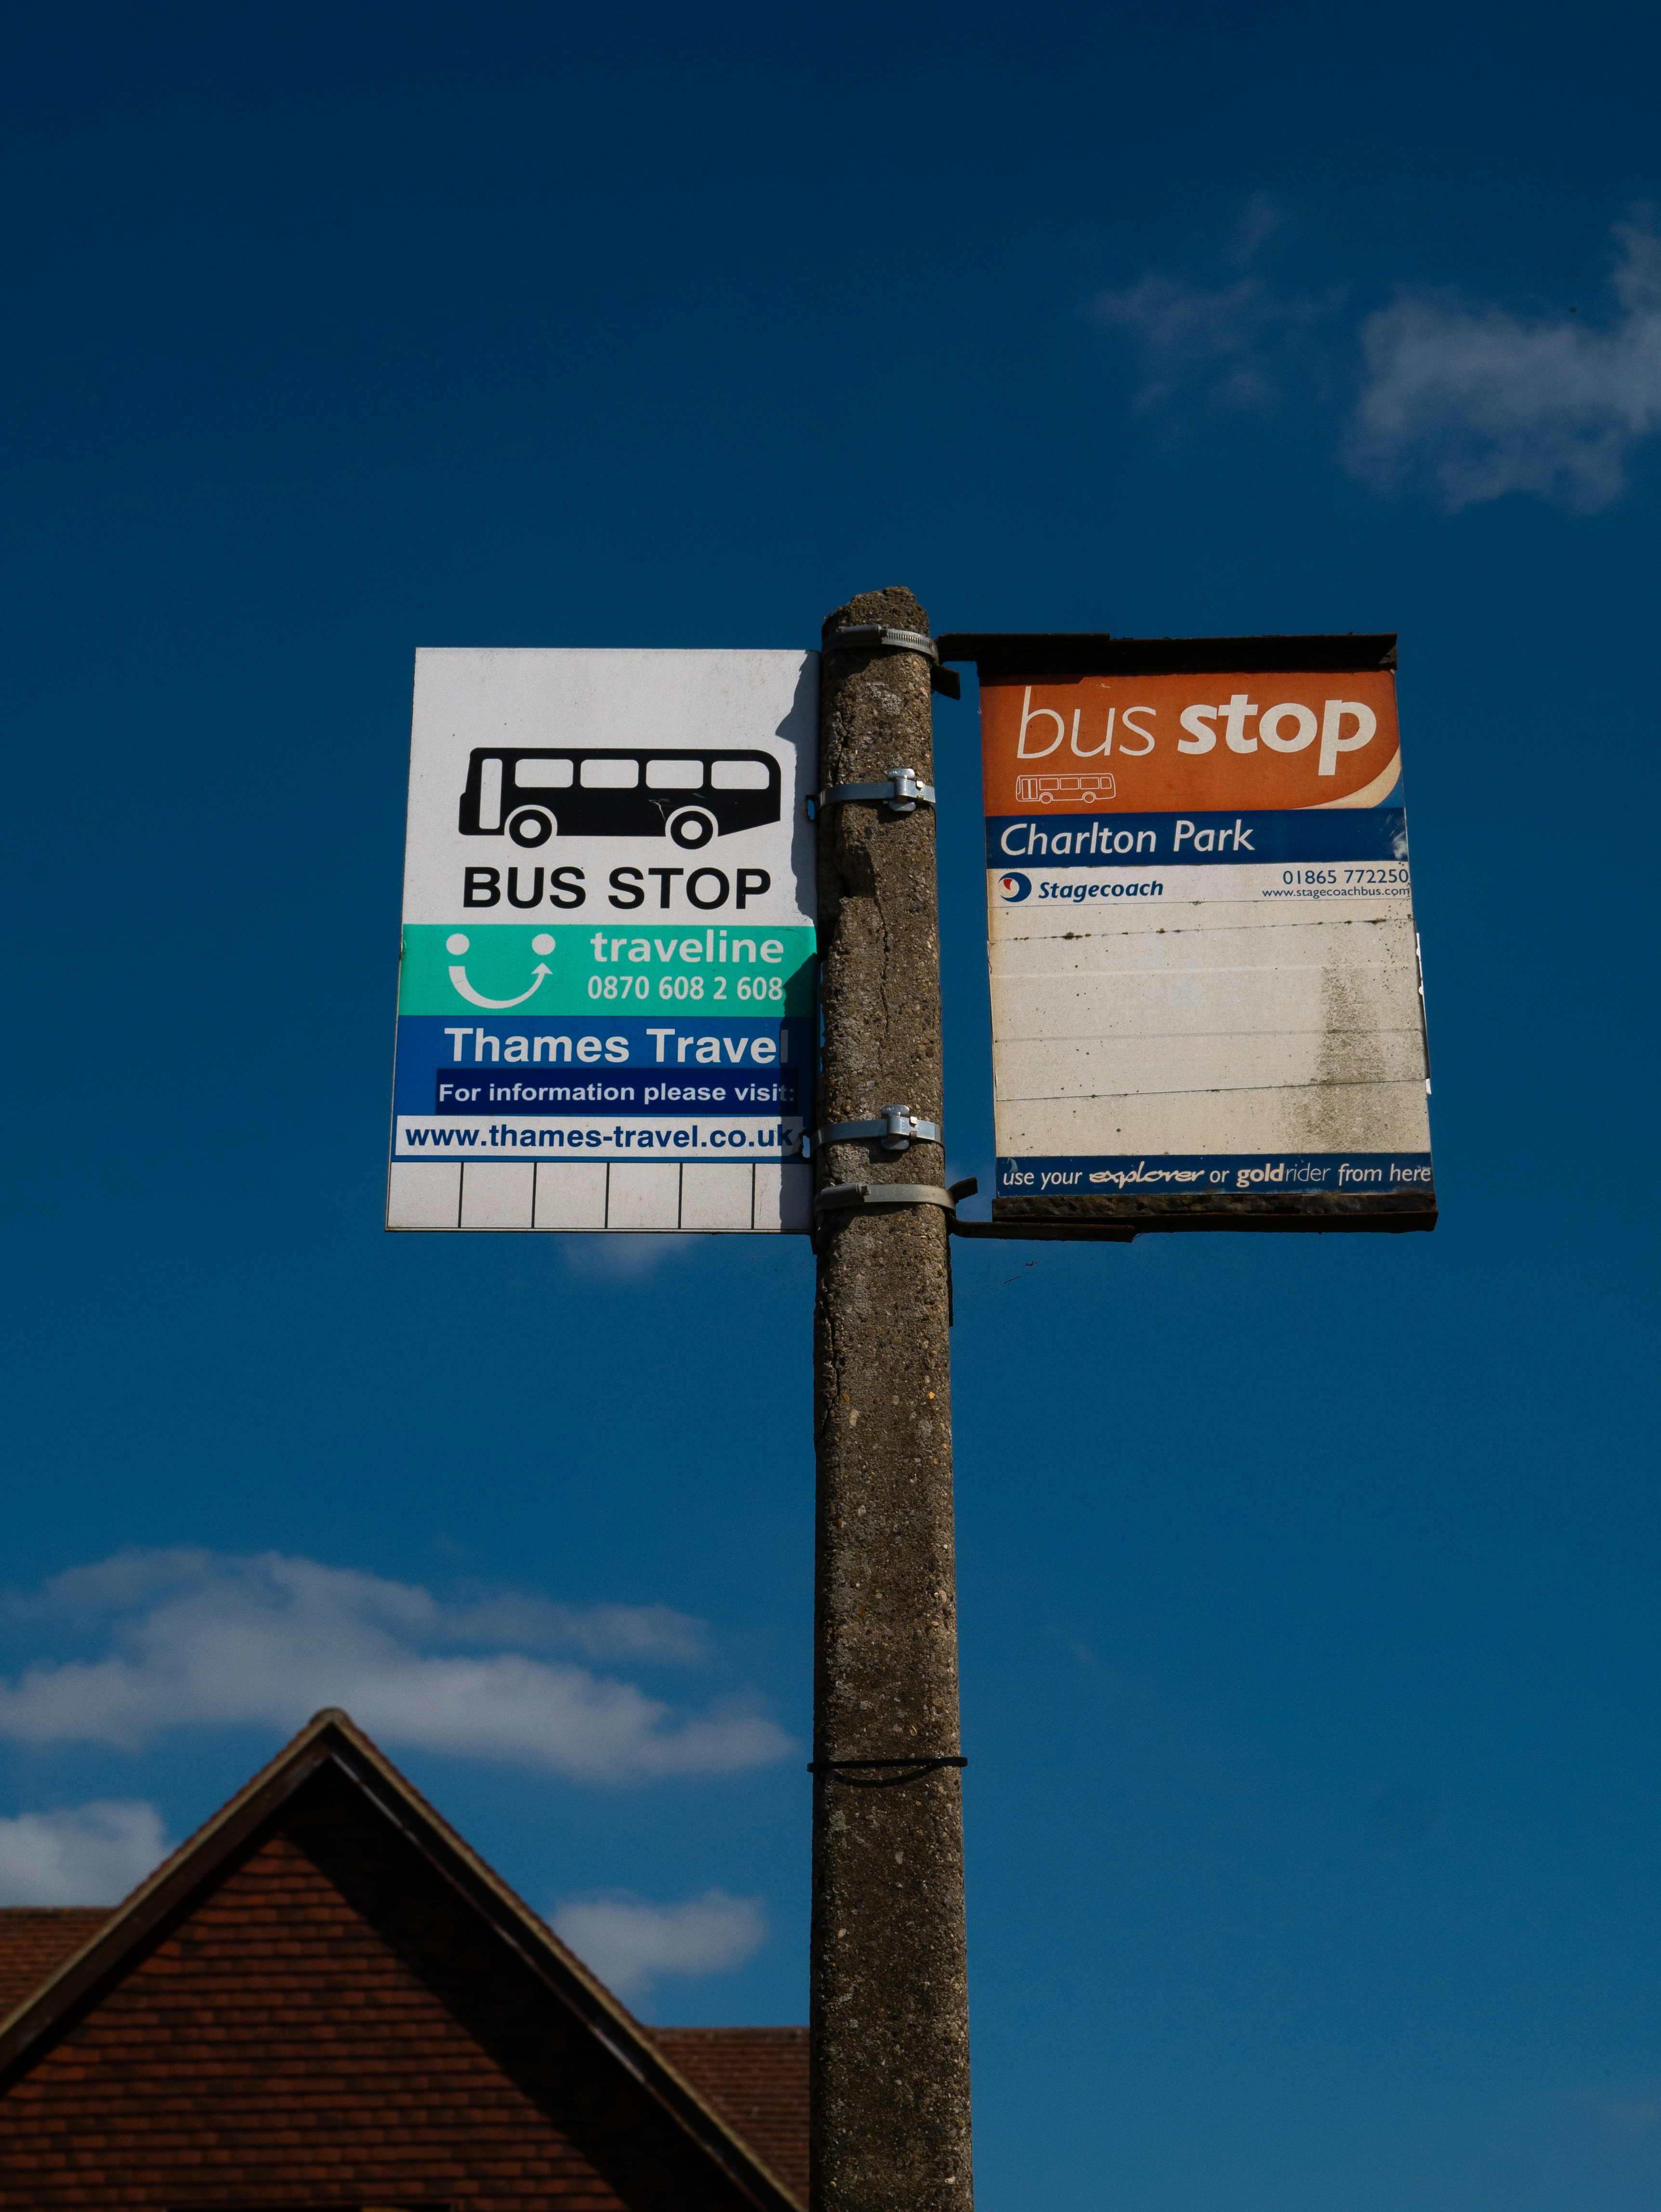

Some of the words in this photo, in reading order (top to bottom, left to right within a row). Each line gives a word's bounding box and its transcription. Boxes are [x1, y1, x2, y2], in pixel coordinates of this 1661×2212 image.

[1017, 686, 1157, 759] bus
[1177, 694, 1377, 776] stop
[1001, 822, 1157, 856] Charlton
[1173, 819, 1255, 852] Park
[463, 867, 586, 909] BUS
[608, 868, 771, 909] STOP
[1282, 870, 1336, 884] 01865
[1344, 869, 1409, 883] 772250
[1038, 881, 1164, 903] Stagecoach
[1262, 886, 1411, 899] www.stagecoachbus.com
[591, 929, 784, 963] traveline
[588, 975, 650, 1000] 0870
[659, 975, 704, 1000] 608
[713, 976, 727, 1000] 2
[737, 976, 783, 1001] 608
[444, 1027, 630, 1063] Thames
[646, 1028, 789, 1064] Travel
[439, 1083, 481, 1102] For
[489, 1083, 635, 1101] information
[645, 1083, 726, 1105] please
[734, 1083, 794, 1101] visit:
[406, 1124, 793, 1148] www.thames-travel.co.uk
[1003, 1172, 1034, 1185] use
[1041, 1172, 1082, 1190] your
[1089, 1161, 1204, 1189] explorer
[1210, 1170, 1229, 1183] or
[1338, 1163, 1382, 1186] from
[1389, 1163, 1431, 1182] here
